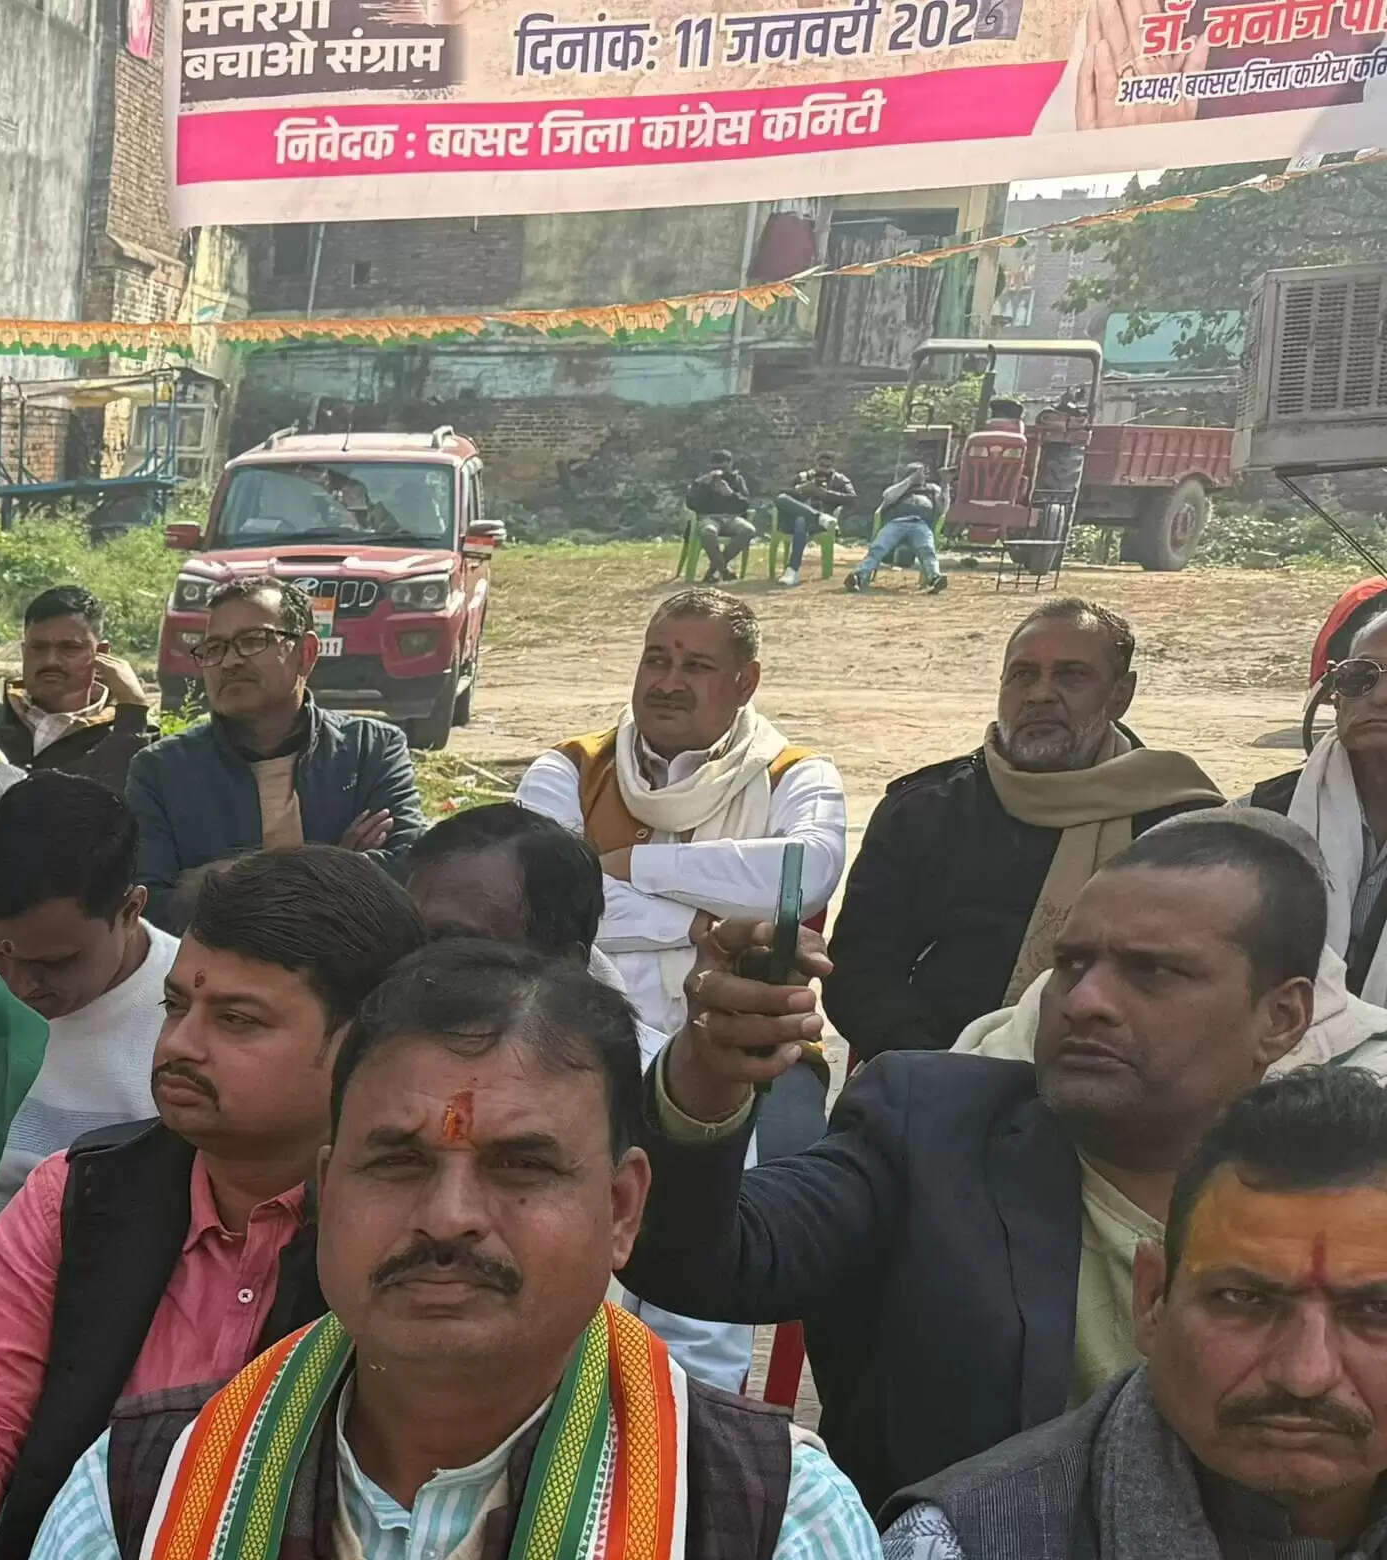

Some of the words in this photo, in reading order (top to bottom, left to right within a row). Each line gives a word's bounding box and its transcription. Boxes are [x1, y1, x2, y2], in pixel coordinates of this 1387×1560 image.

[183, 30, 319, 81] बचाओ
[324, 27, 446, 74] संग्राम
[514, 13, 659, 76] दिनांक:
[674, 18, 712, 68] 11
[725, 0, 882, 63] जनवरी
[1185, 70, 1243, 97] बक्सर
[1243, 60, 1292, 91] जिला
[1294, 53, 1350, 84] कांग्रेस
[273, 116, 400, 165] निवेदक
[426, 122, 533, 159] बक्सर
[539, 110, 635, 157] जिला
[639, 102, 757, 153] कांग्रेस
[760, 89, 888, 143] कमिटी
